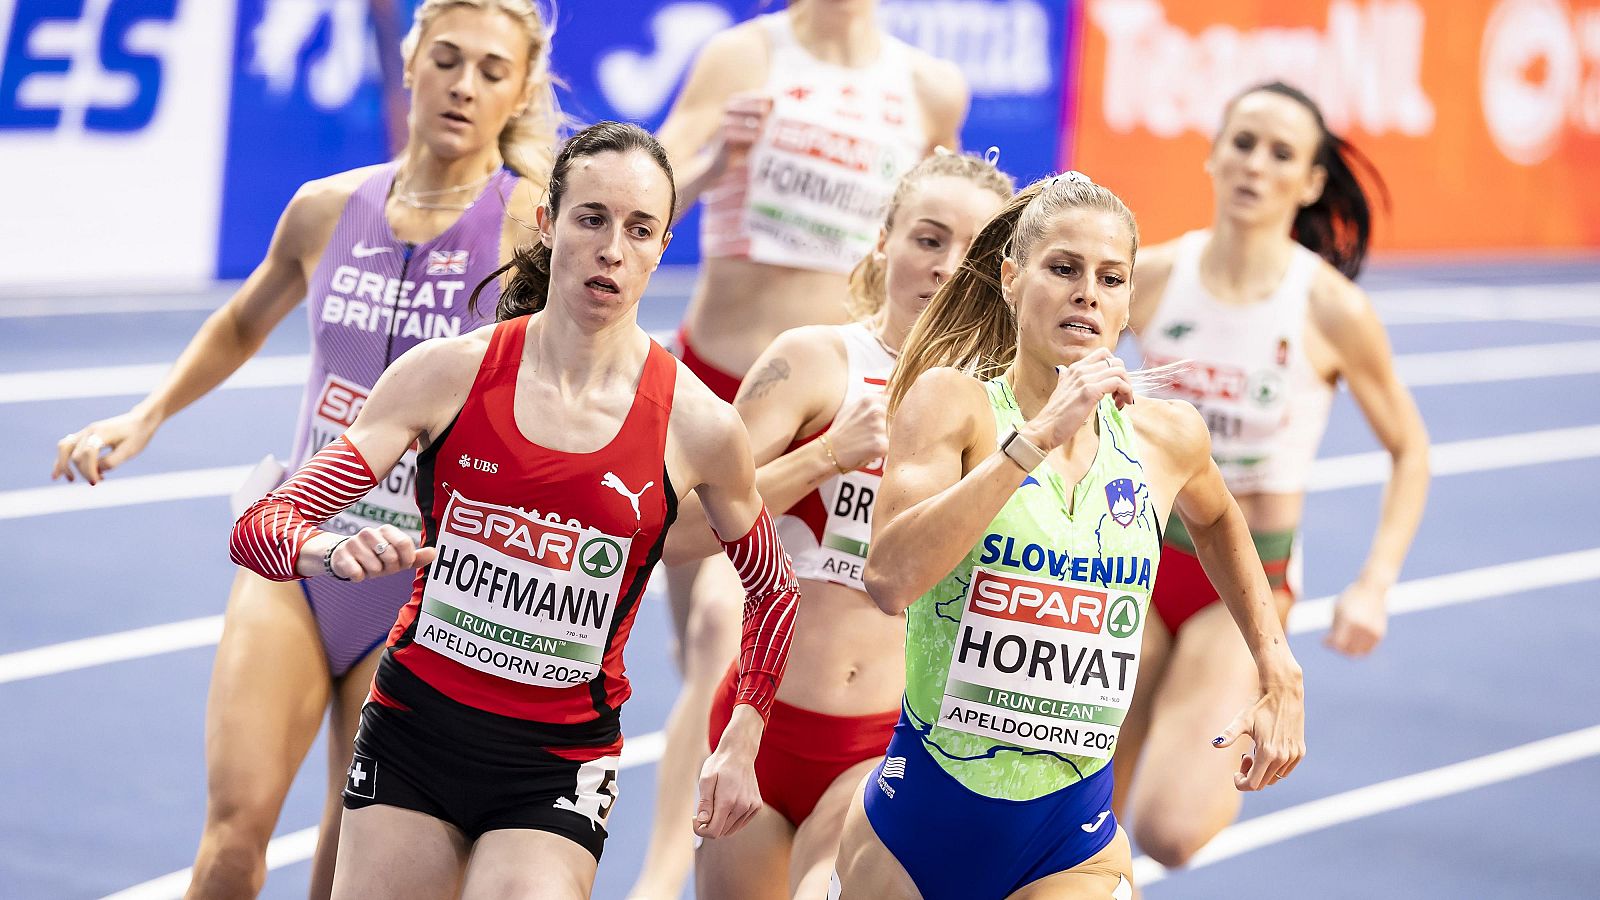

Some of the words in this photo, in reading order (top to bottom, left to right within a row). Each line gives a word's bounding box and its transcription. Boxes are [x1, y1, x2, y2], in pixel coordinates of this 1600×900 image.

[331, 265, 465, 309] GREAT
[322, 294, 461, 340] BRITAIN
[473, 459, 499, 474] UBS
[834, 481, 874, 524] BR
[450, 506, 573, 565] SPAR
[980, 533, 1151, 588] SLOVENIJA
[432, 544, 610, 630] HOFFMANN
[975, 580, 1104, 628] SPAR
[454, 612, 462, 625] I
[462, 613, 498, 639] RUN
[422, 623, 540, 677] APELDOORN
[957, 625, 1136, 691] HORVAT
[988, 689, 994, 703] I
[995, 691, 1037, 713] RUN
[949, 706, 1079, 746] APELDOORN
[1082, 730, 1116, 751] 202
